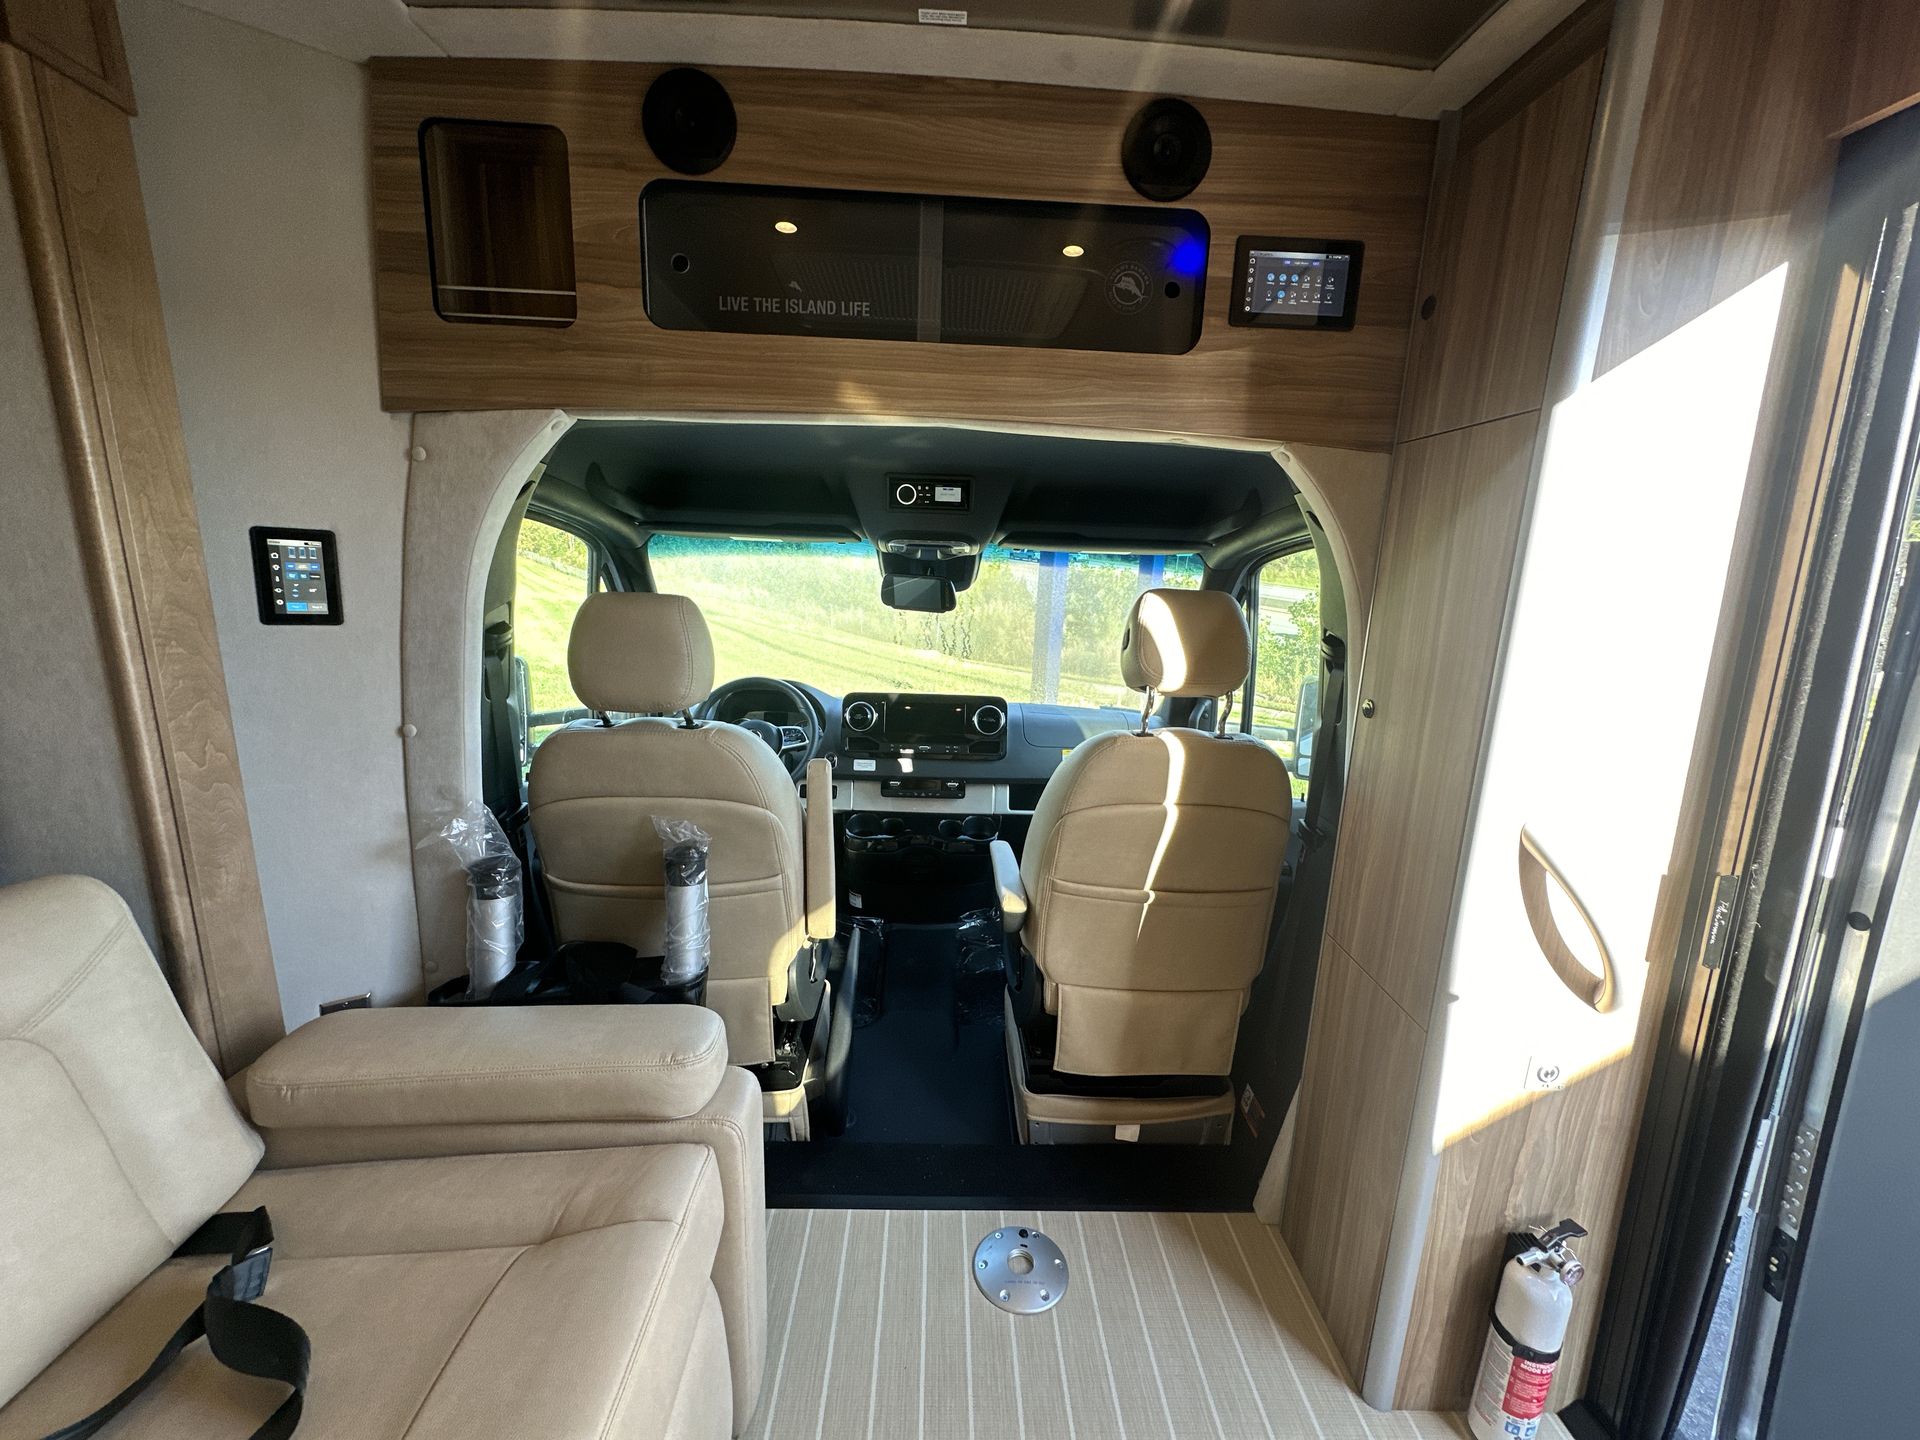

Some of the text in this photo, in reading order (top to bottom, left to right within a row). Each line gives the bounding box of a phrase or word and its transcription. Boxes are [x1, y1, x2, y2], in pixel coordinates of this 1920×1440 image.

[718, 295, 871, 317] LIVE THE ISLAND LIFE
